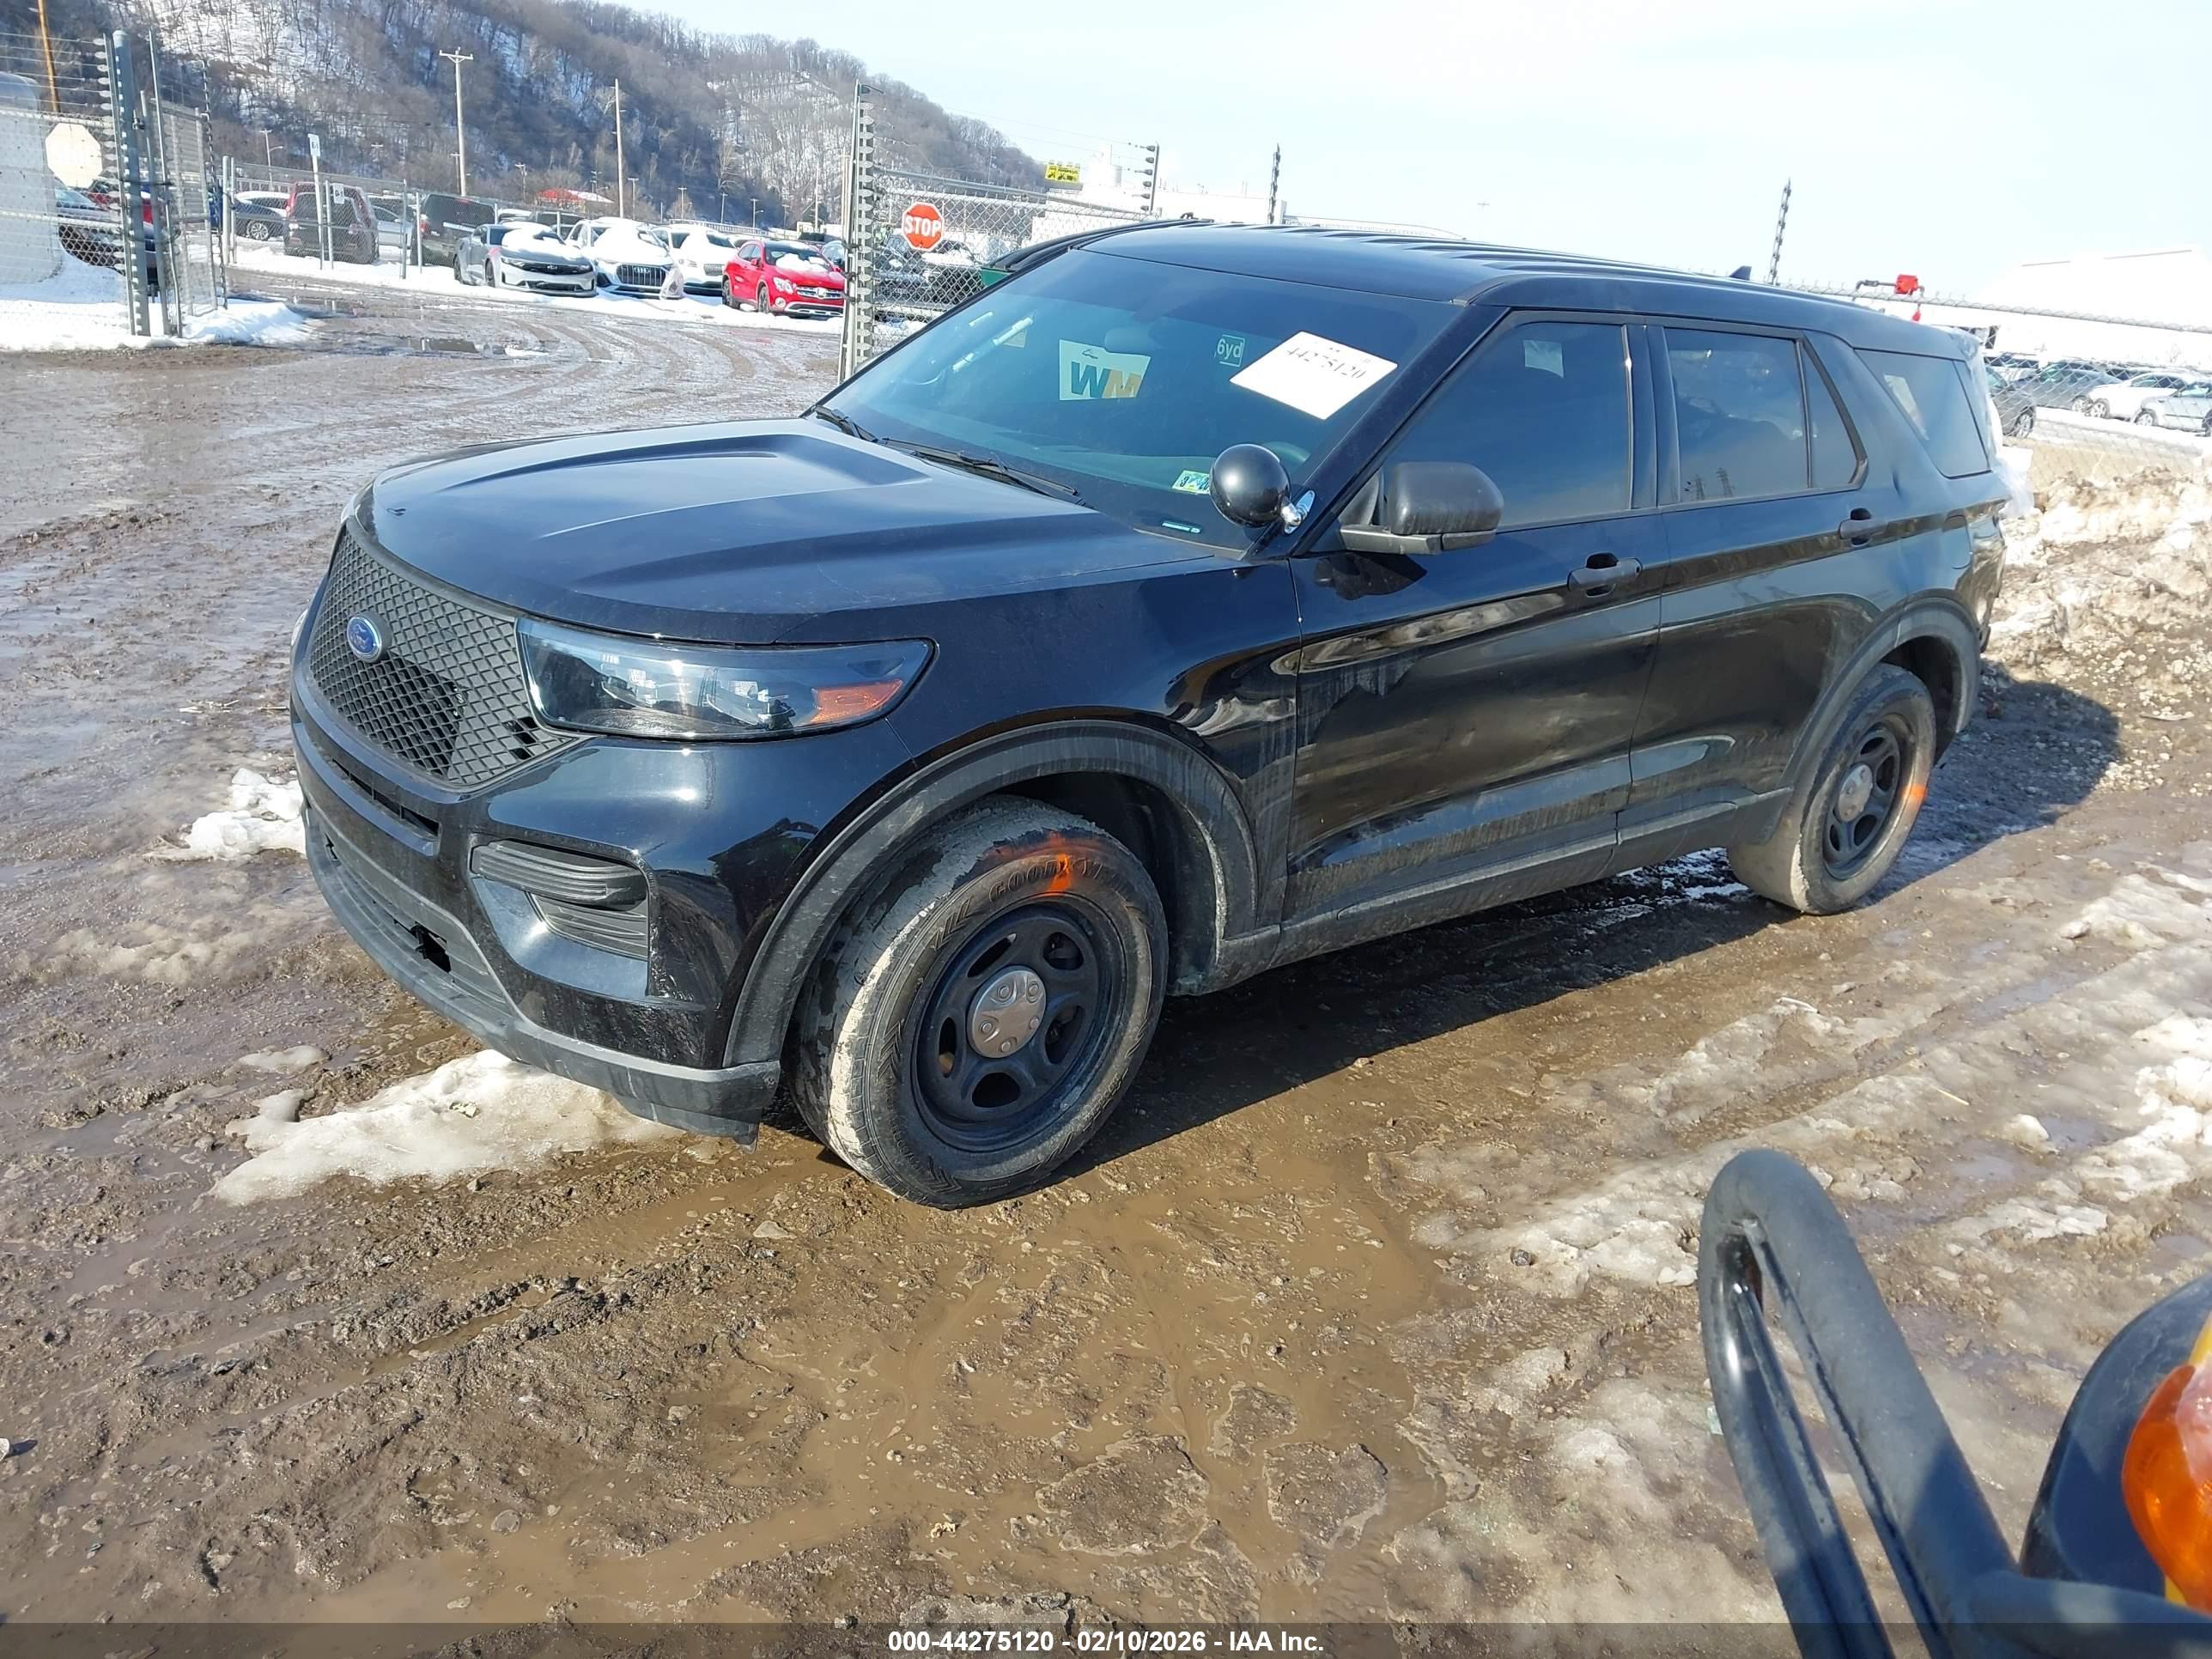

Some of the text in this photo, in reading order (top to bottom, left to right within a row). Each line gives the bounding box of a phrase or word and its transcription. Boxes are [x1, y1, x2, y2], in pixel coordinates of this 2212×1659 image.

[904, 216, 942, 238] STOP
[1217, 338, 1243, 360] 6yd
[1071, 361, 1141, 398] WM
